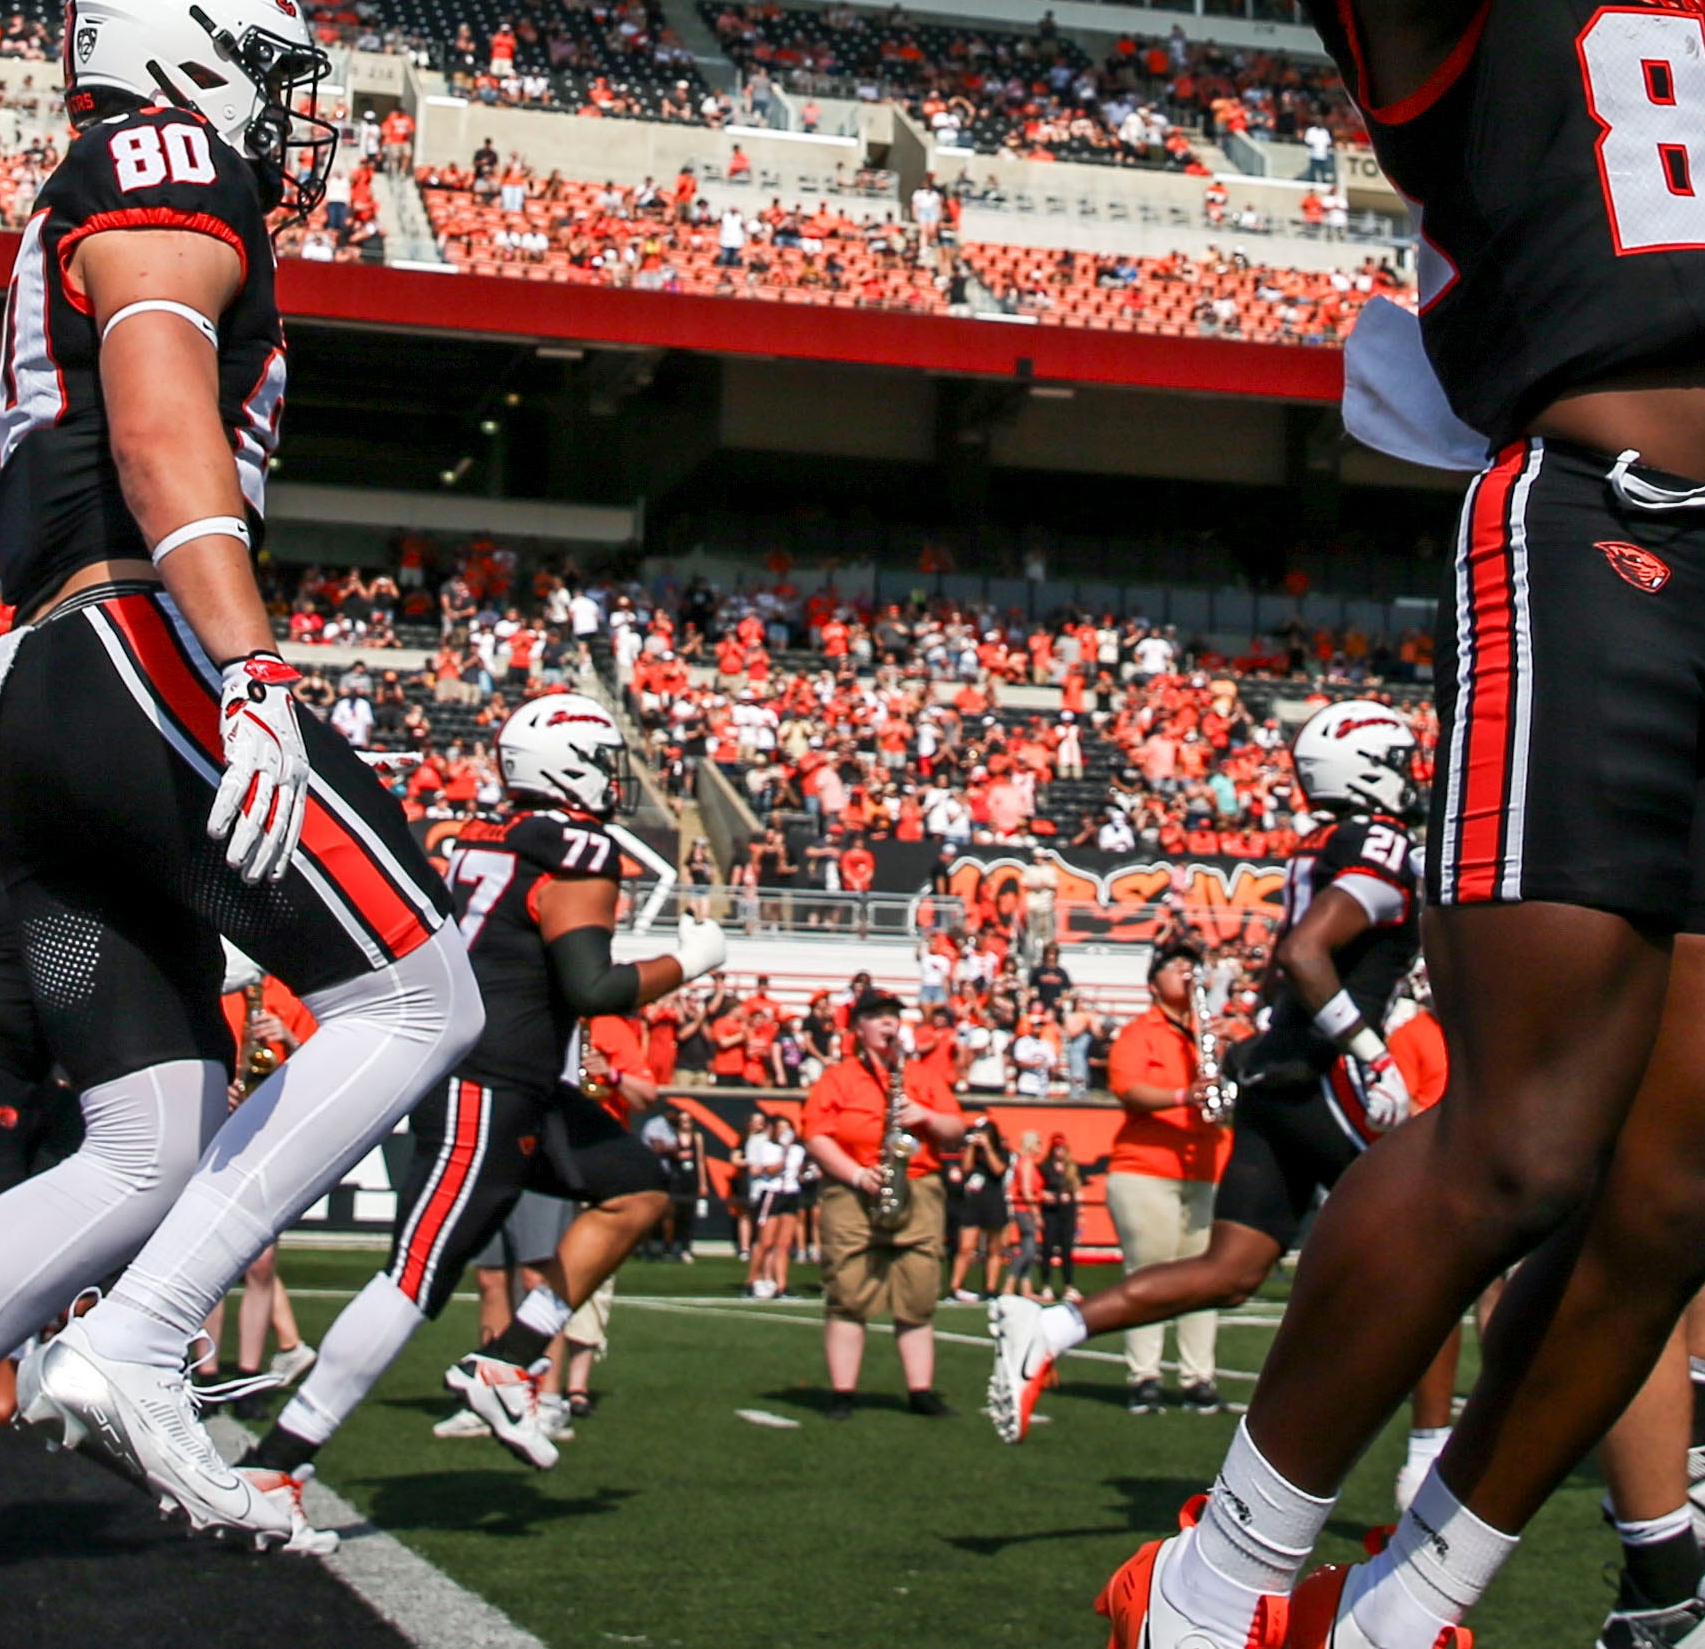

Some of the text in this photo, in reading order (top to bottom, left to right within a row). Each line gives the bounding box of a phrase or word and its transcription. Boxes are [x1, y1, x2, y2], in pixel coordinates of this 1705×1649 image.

[108, 122, 217, 194] 80
[561, 826, 611, 872] 77
[1360, 824, 1411, 873] 21
